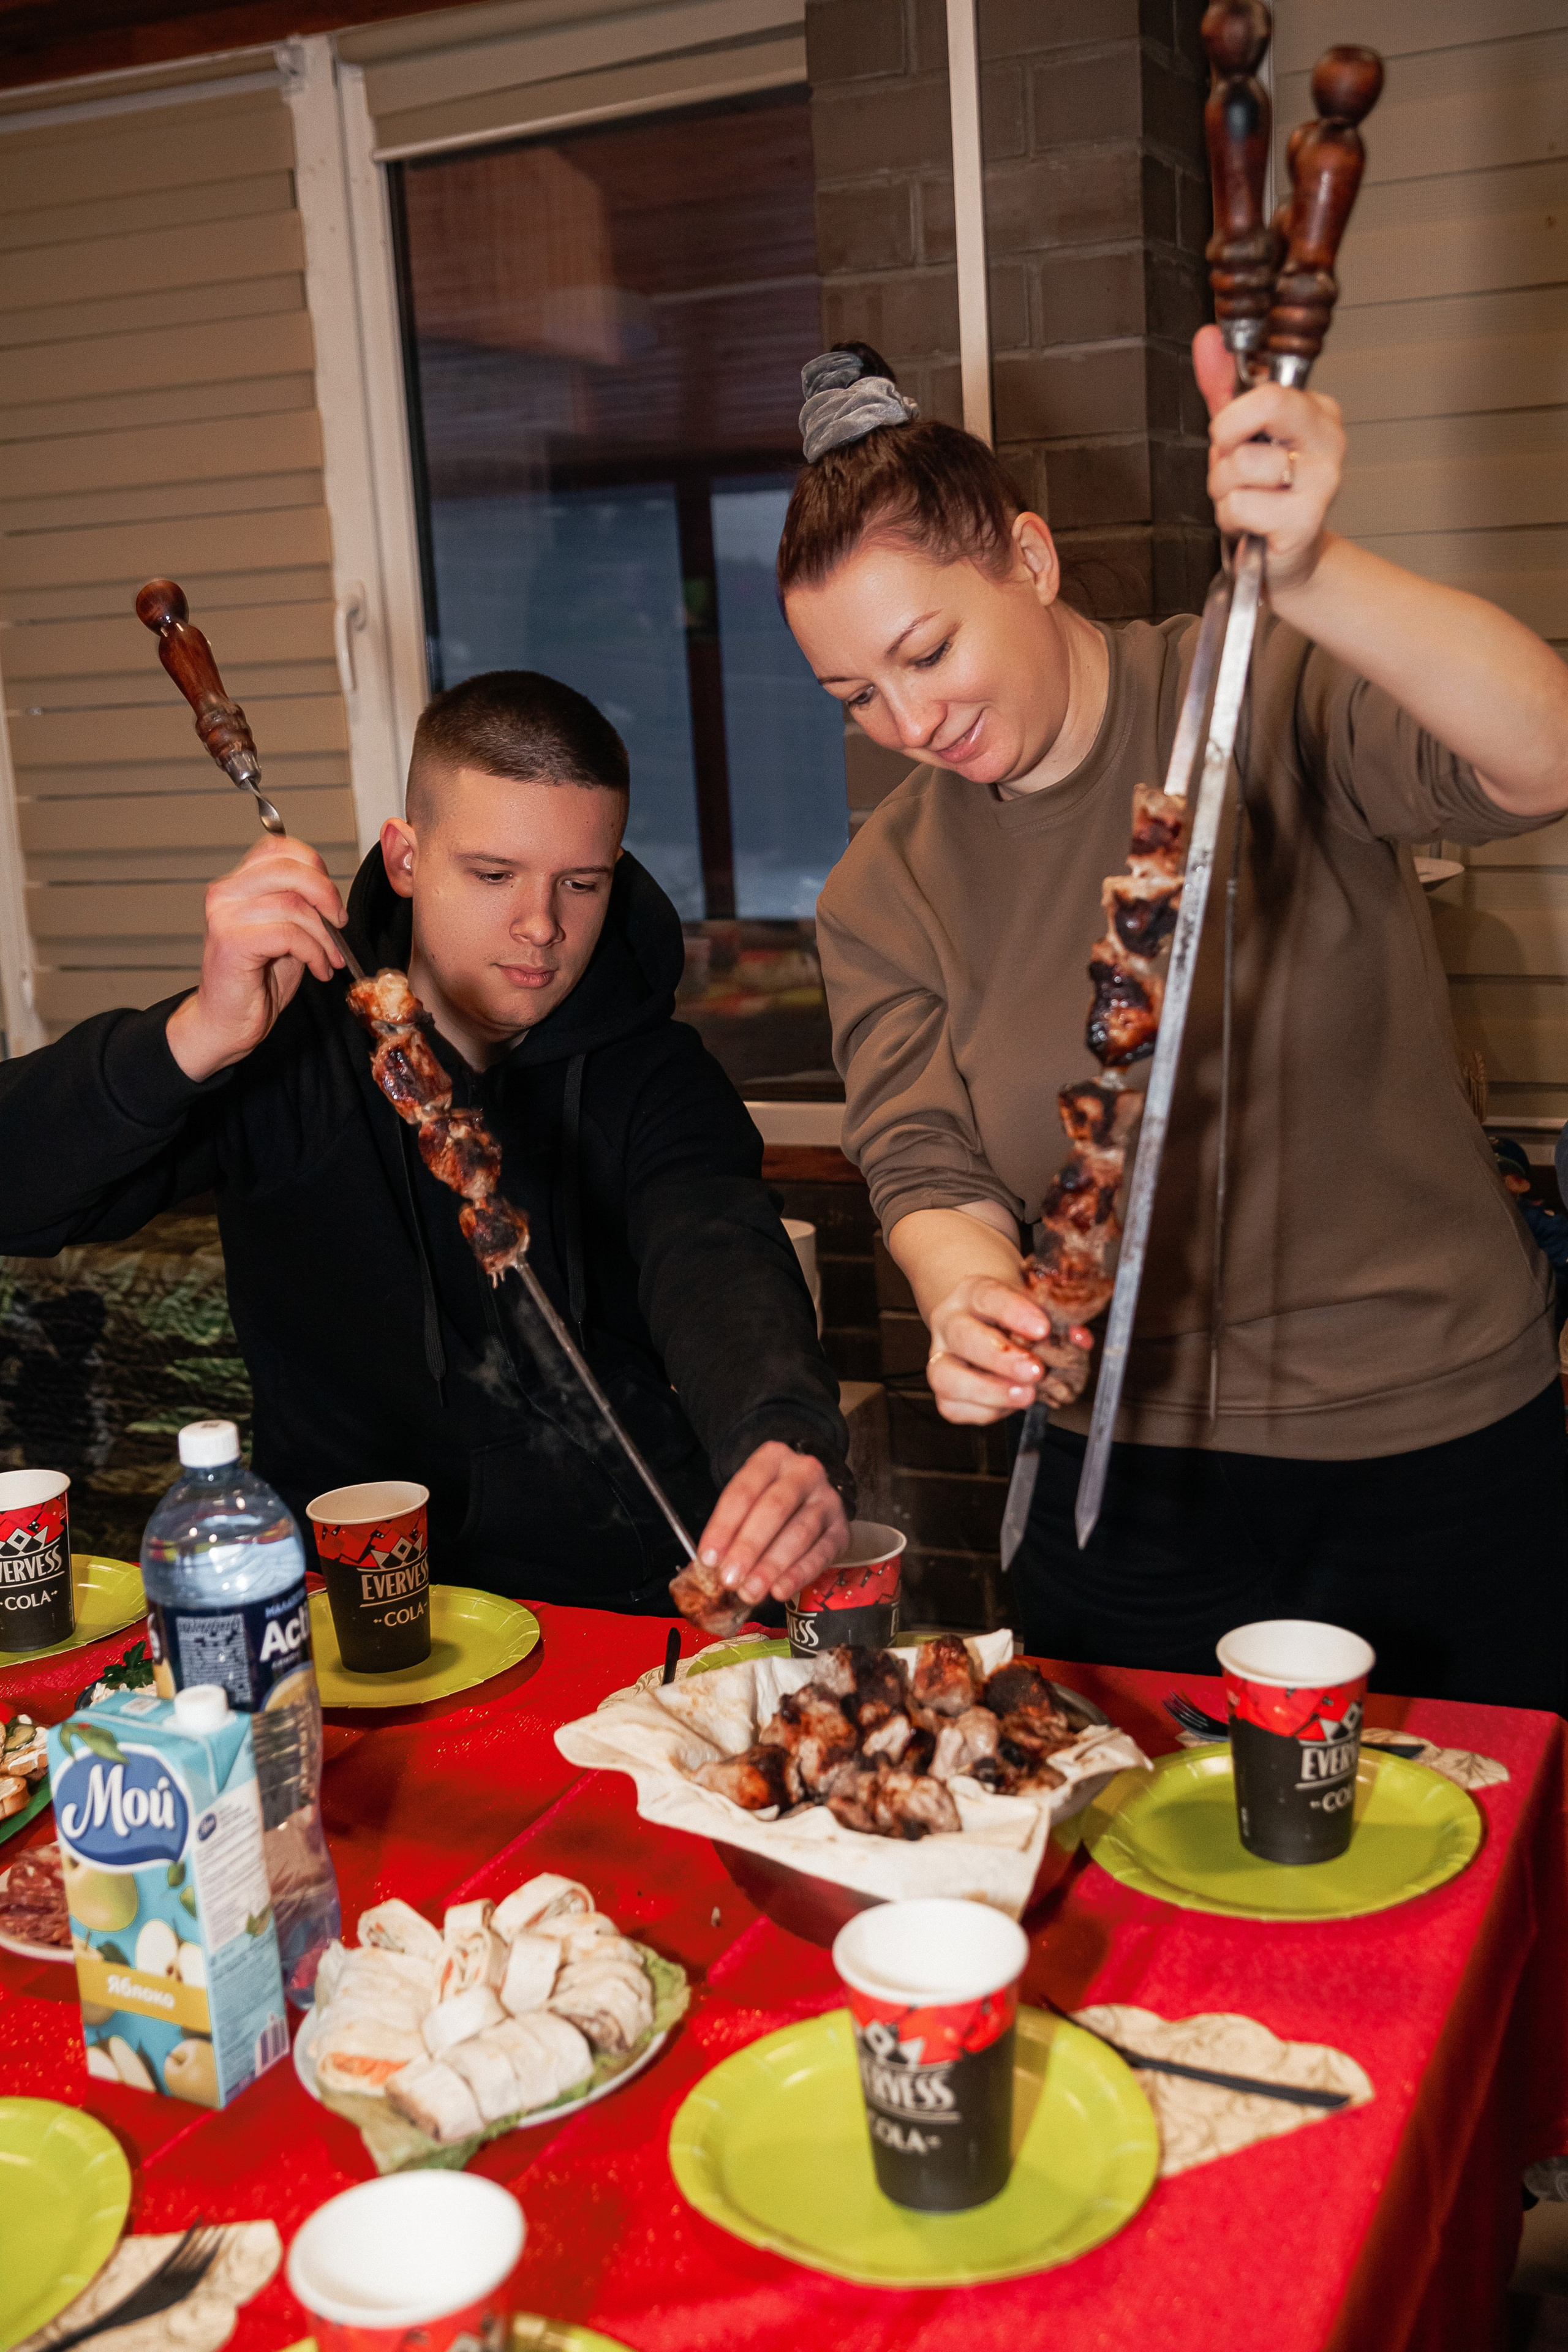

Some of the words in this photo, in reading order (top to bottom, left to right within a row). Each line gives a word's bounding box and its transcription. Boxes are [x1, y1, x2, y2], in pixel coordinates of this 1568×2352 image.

[0, 1545, 62, 1583] ERVESS
[4, 1590, 51, 1610] COLA
[384, 1602, 424, 1626] COLA
[61, 1763, 175, 1839] Мой
